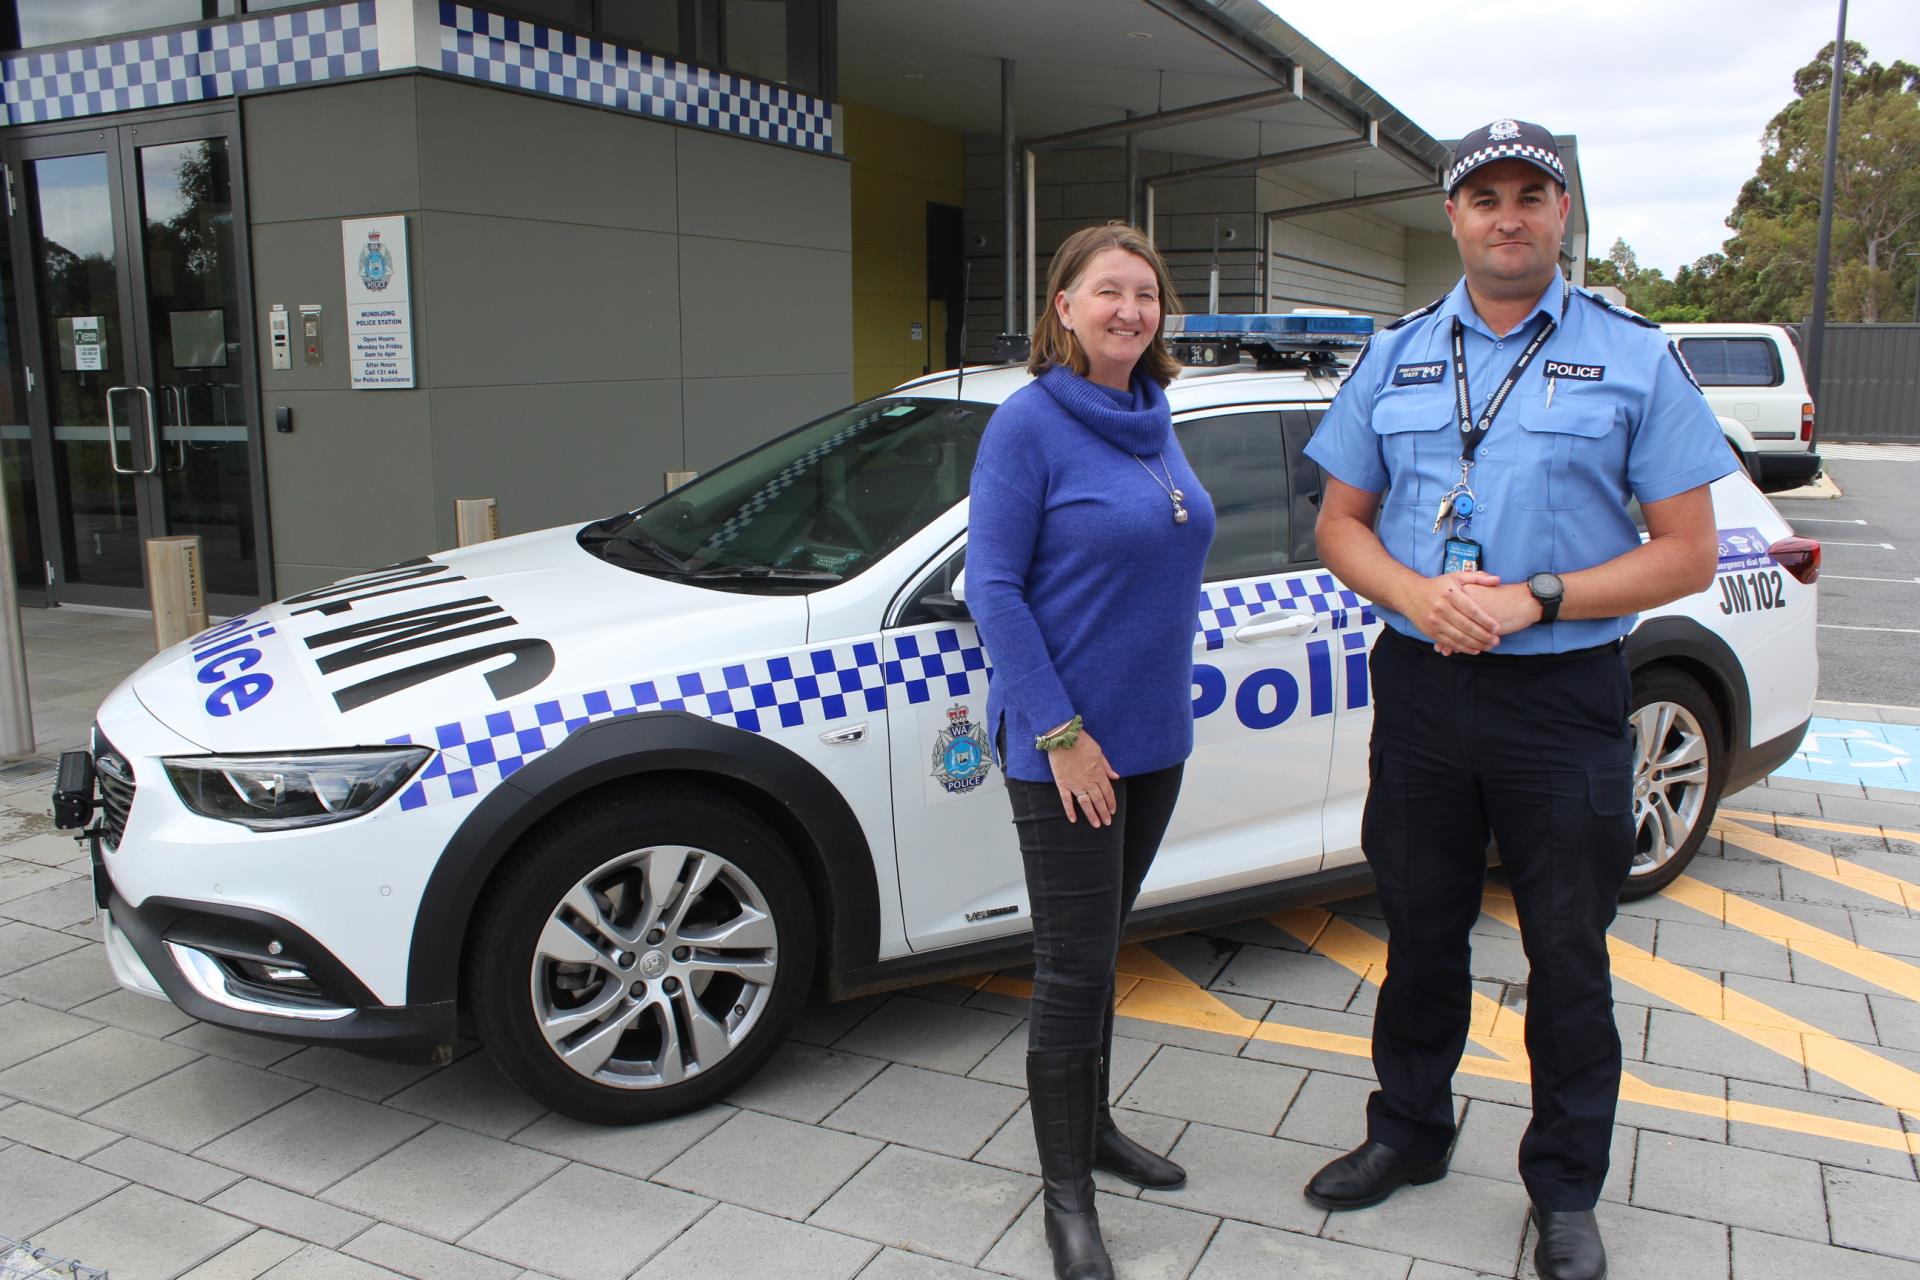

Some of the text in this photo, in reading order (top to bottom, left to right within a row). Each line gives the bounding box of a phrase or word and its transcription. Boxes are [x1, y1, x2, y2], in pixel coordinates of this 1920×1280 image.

[1547, 362, 1601, 378] POLICE
[1746, 558, 1758, 567] dial
[1718, 570, 1786, 615] JM102
[282, 554, 556, 713] JM10
[190, 605, 276, 717] olice
[951, 726, 968, 736] WA
[948, 776, 981, 791] POLICE
